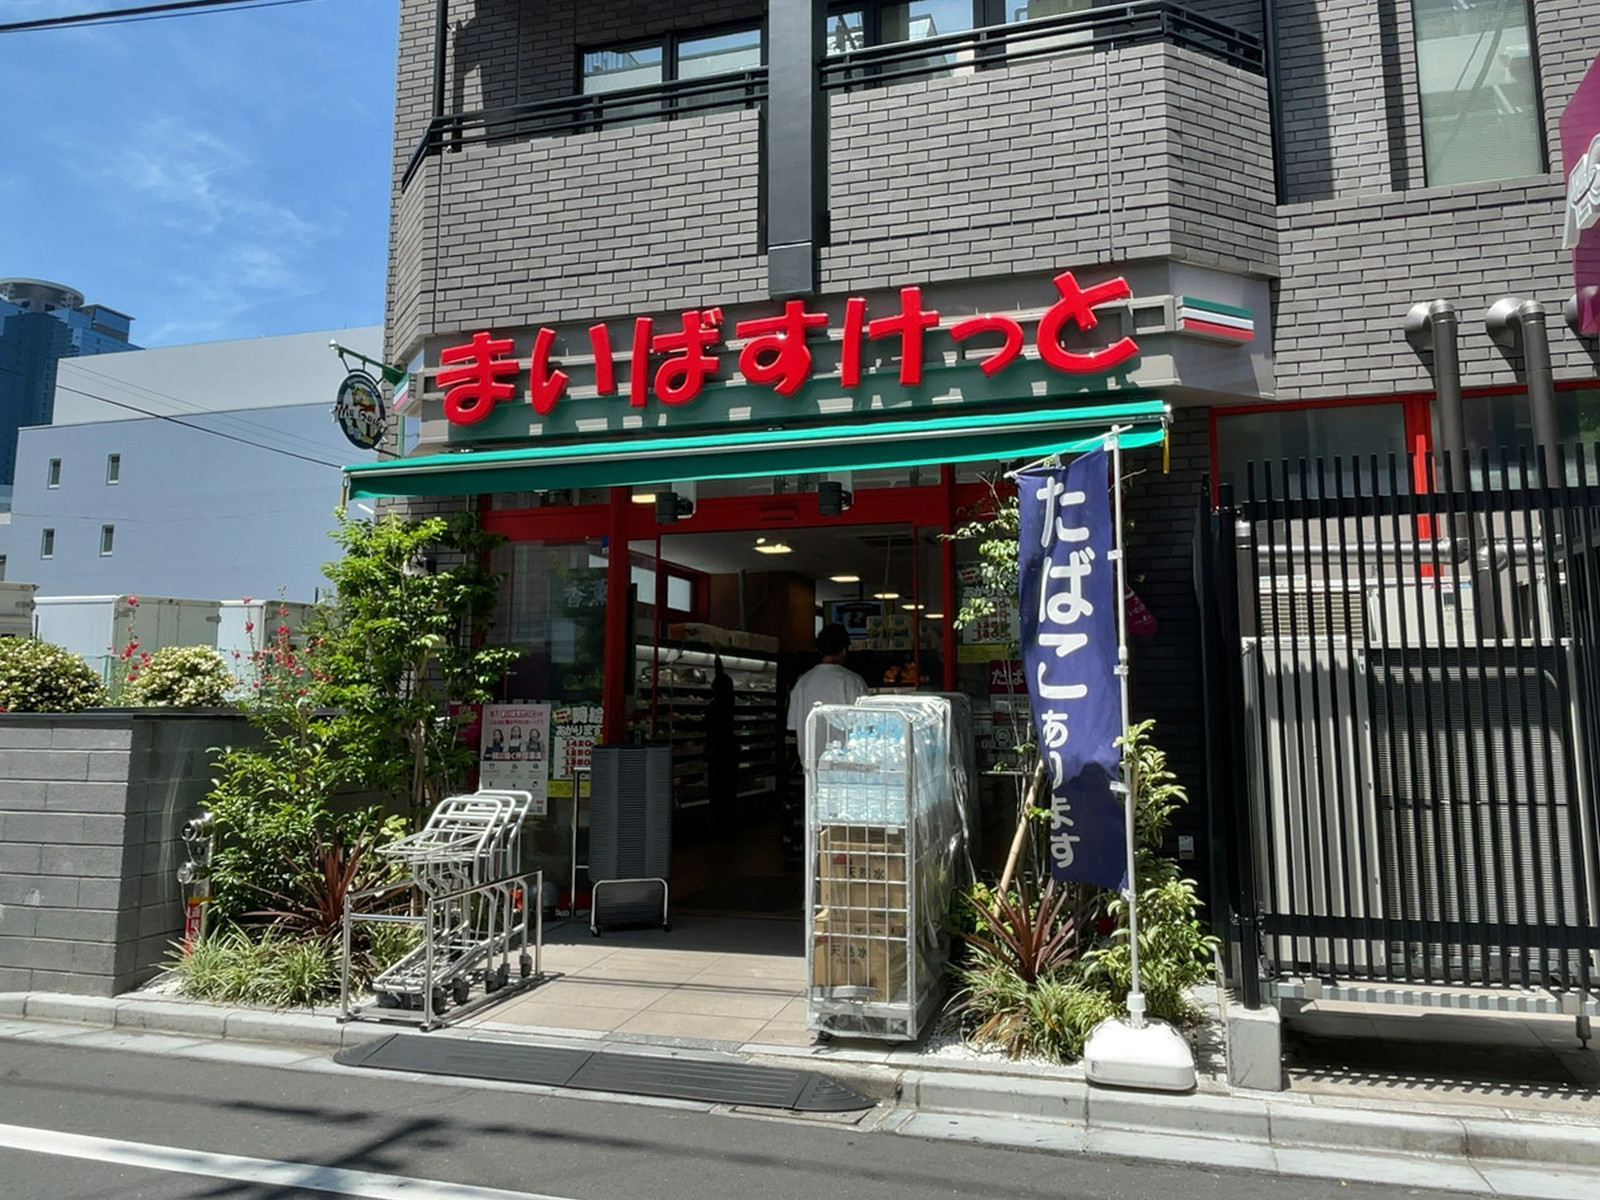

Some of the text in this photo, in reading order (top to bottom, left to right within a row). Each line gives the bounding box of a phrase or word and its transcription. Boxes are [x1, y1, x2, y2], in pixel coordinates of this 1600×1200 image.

[435, 269, 1141, 426] まいばすけっと
